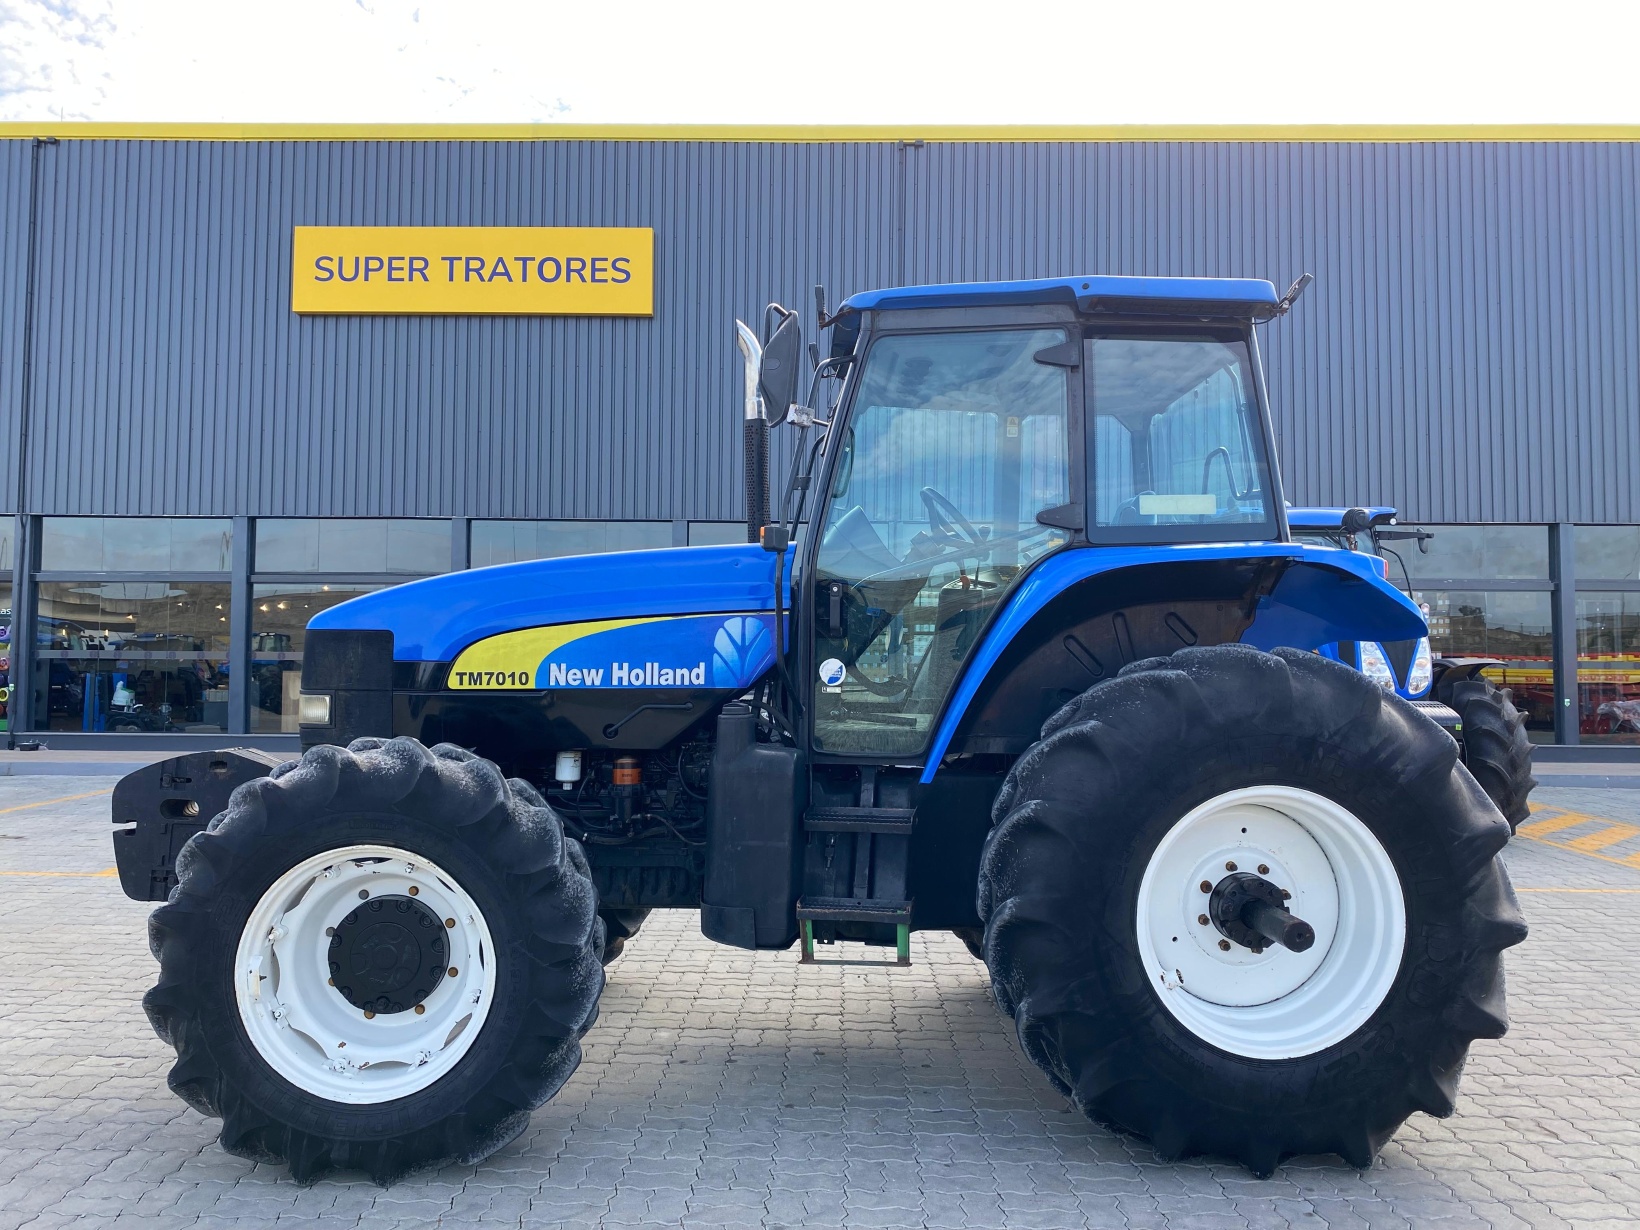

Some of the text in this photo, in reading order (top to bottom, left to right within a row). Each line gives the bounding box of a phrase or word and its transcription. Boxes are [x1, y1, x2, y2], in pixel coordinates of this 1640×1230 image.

[313, 255, 632, 284] SUPER TRATORES
[455, 671, 530, 687] TM7010
[549, 662, 705, 687] New Holland
